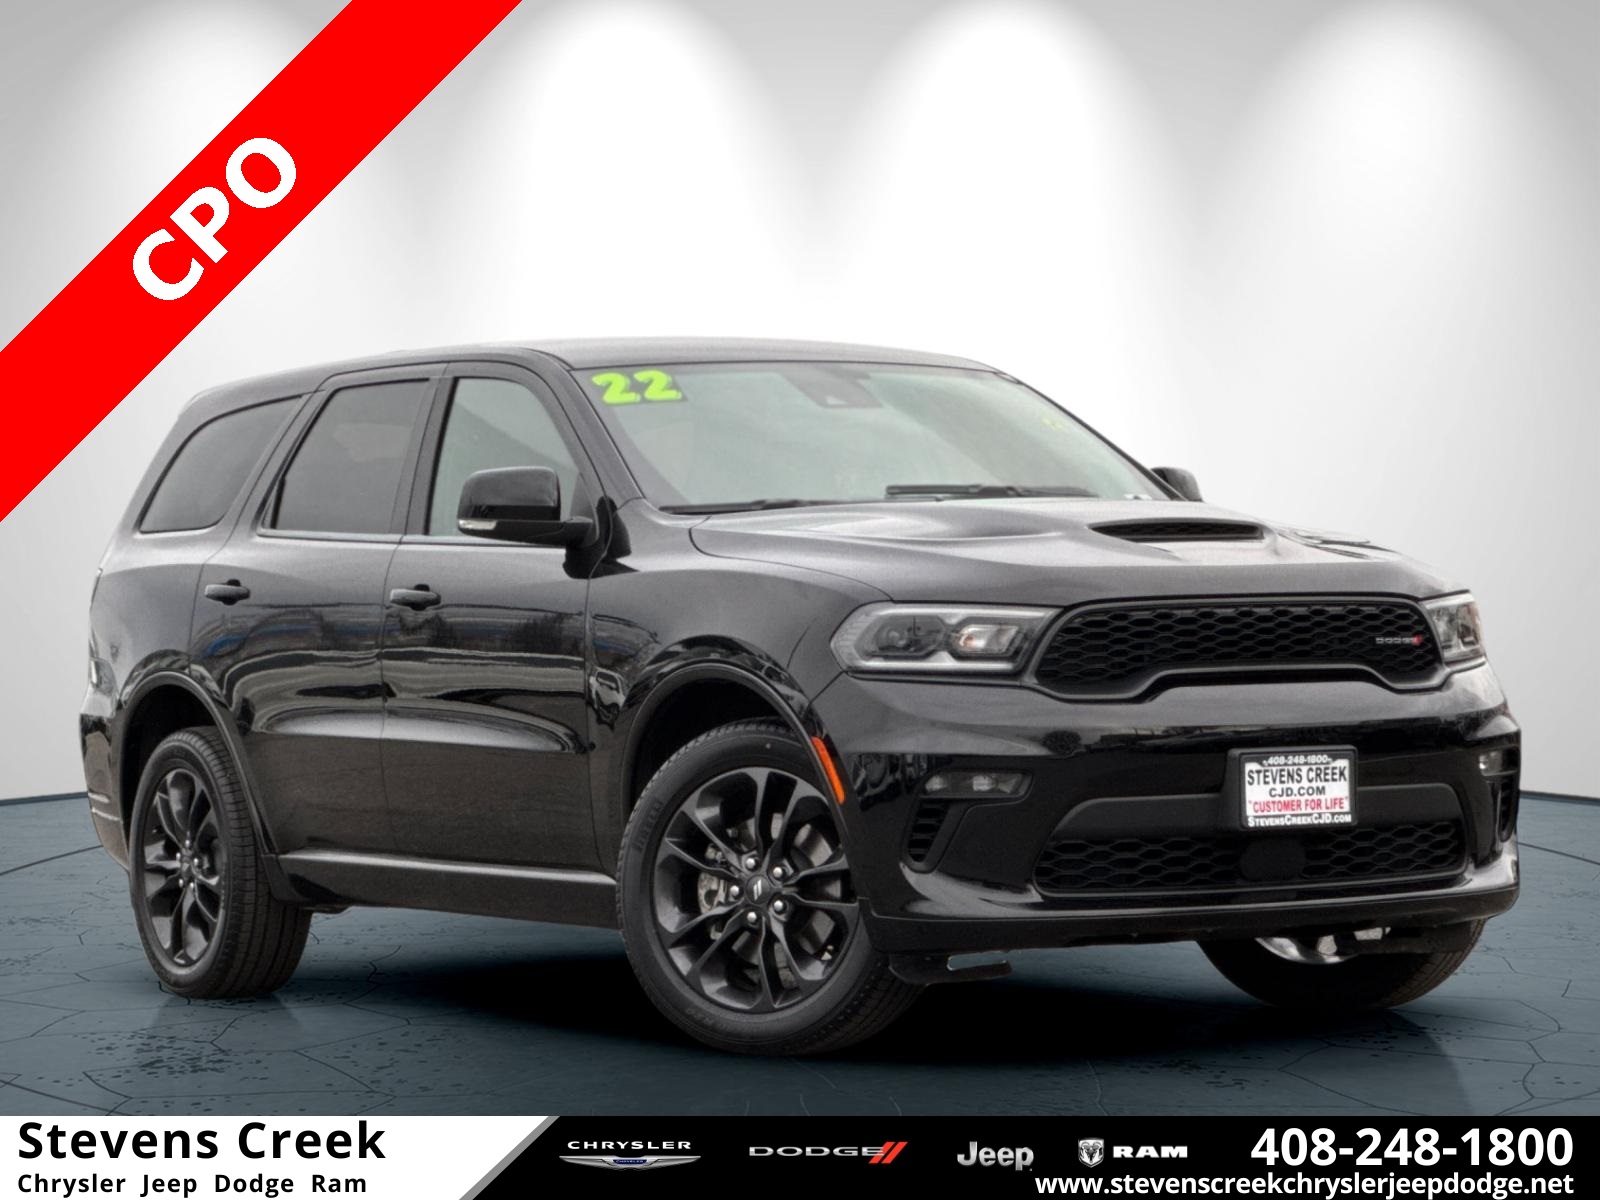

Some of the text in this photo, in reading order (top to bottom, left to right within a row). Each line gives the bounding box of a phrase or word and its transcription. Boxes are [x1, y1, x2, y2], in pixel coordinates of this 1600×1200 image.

[593, 369, 681, 404] 22
[1267, 754, 1328, 765] 408-248-1800
[1247, 766, 1348, 786] STEVENS CREEK
[1268, 785, 1326, 798] CJD.COM
[1304, 798, 1322, 811] FOR
